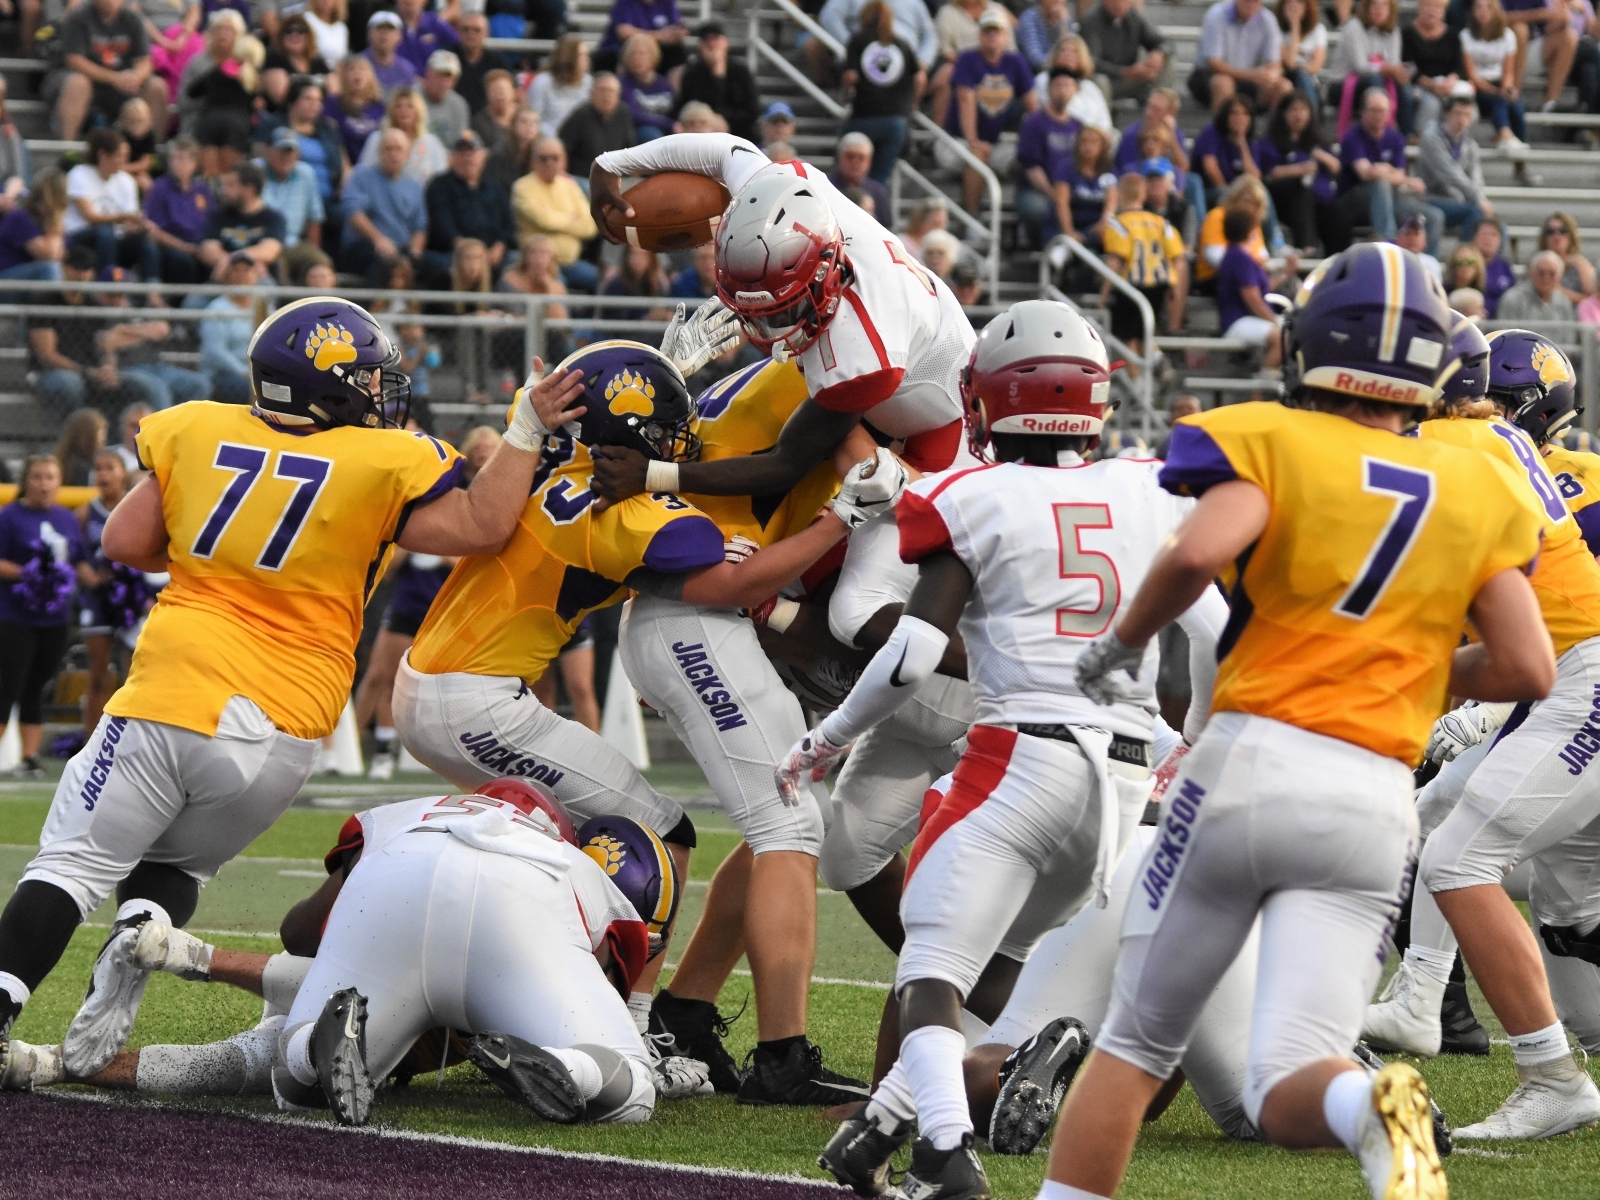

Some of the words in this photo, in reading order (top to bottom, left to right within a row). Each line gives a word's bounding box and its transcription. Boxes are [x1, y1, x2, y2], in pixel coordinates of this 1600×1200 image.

[1022, 418, 1091, 432] Riddell
[1334, 371, 1421, 402] Riddell
[189, 440, 335, 573] 77
[1488, 416, 1569, 526] 8
[1052, 502, 1121, 638] 5
[1331, 454, 1438, 621] 7
[671, 641, 748, 732] JACKSON
[459, 730, 565, 788] JACKSON
[1142, 777, 1207, 911] JACKSON
